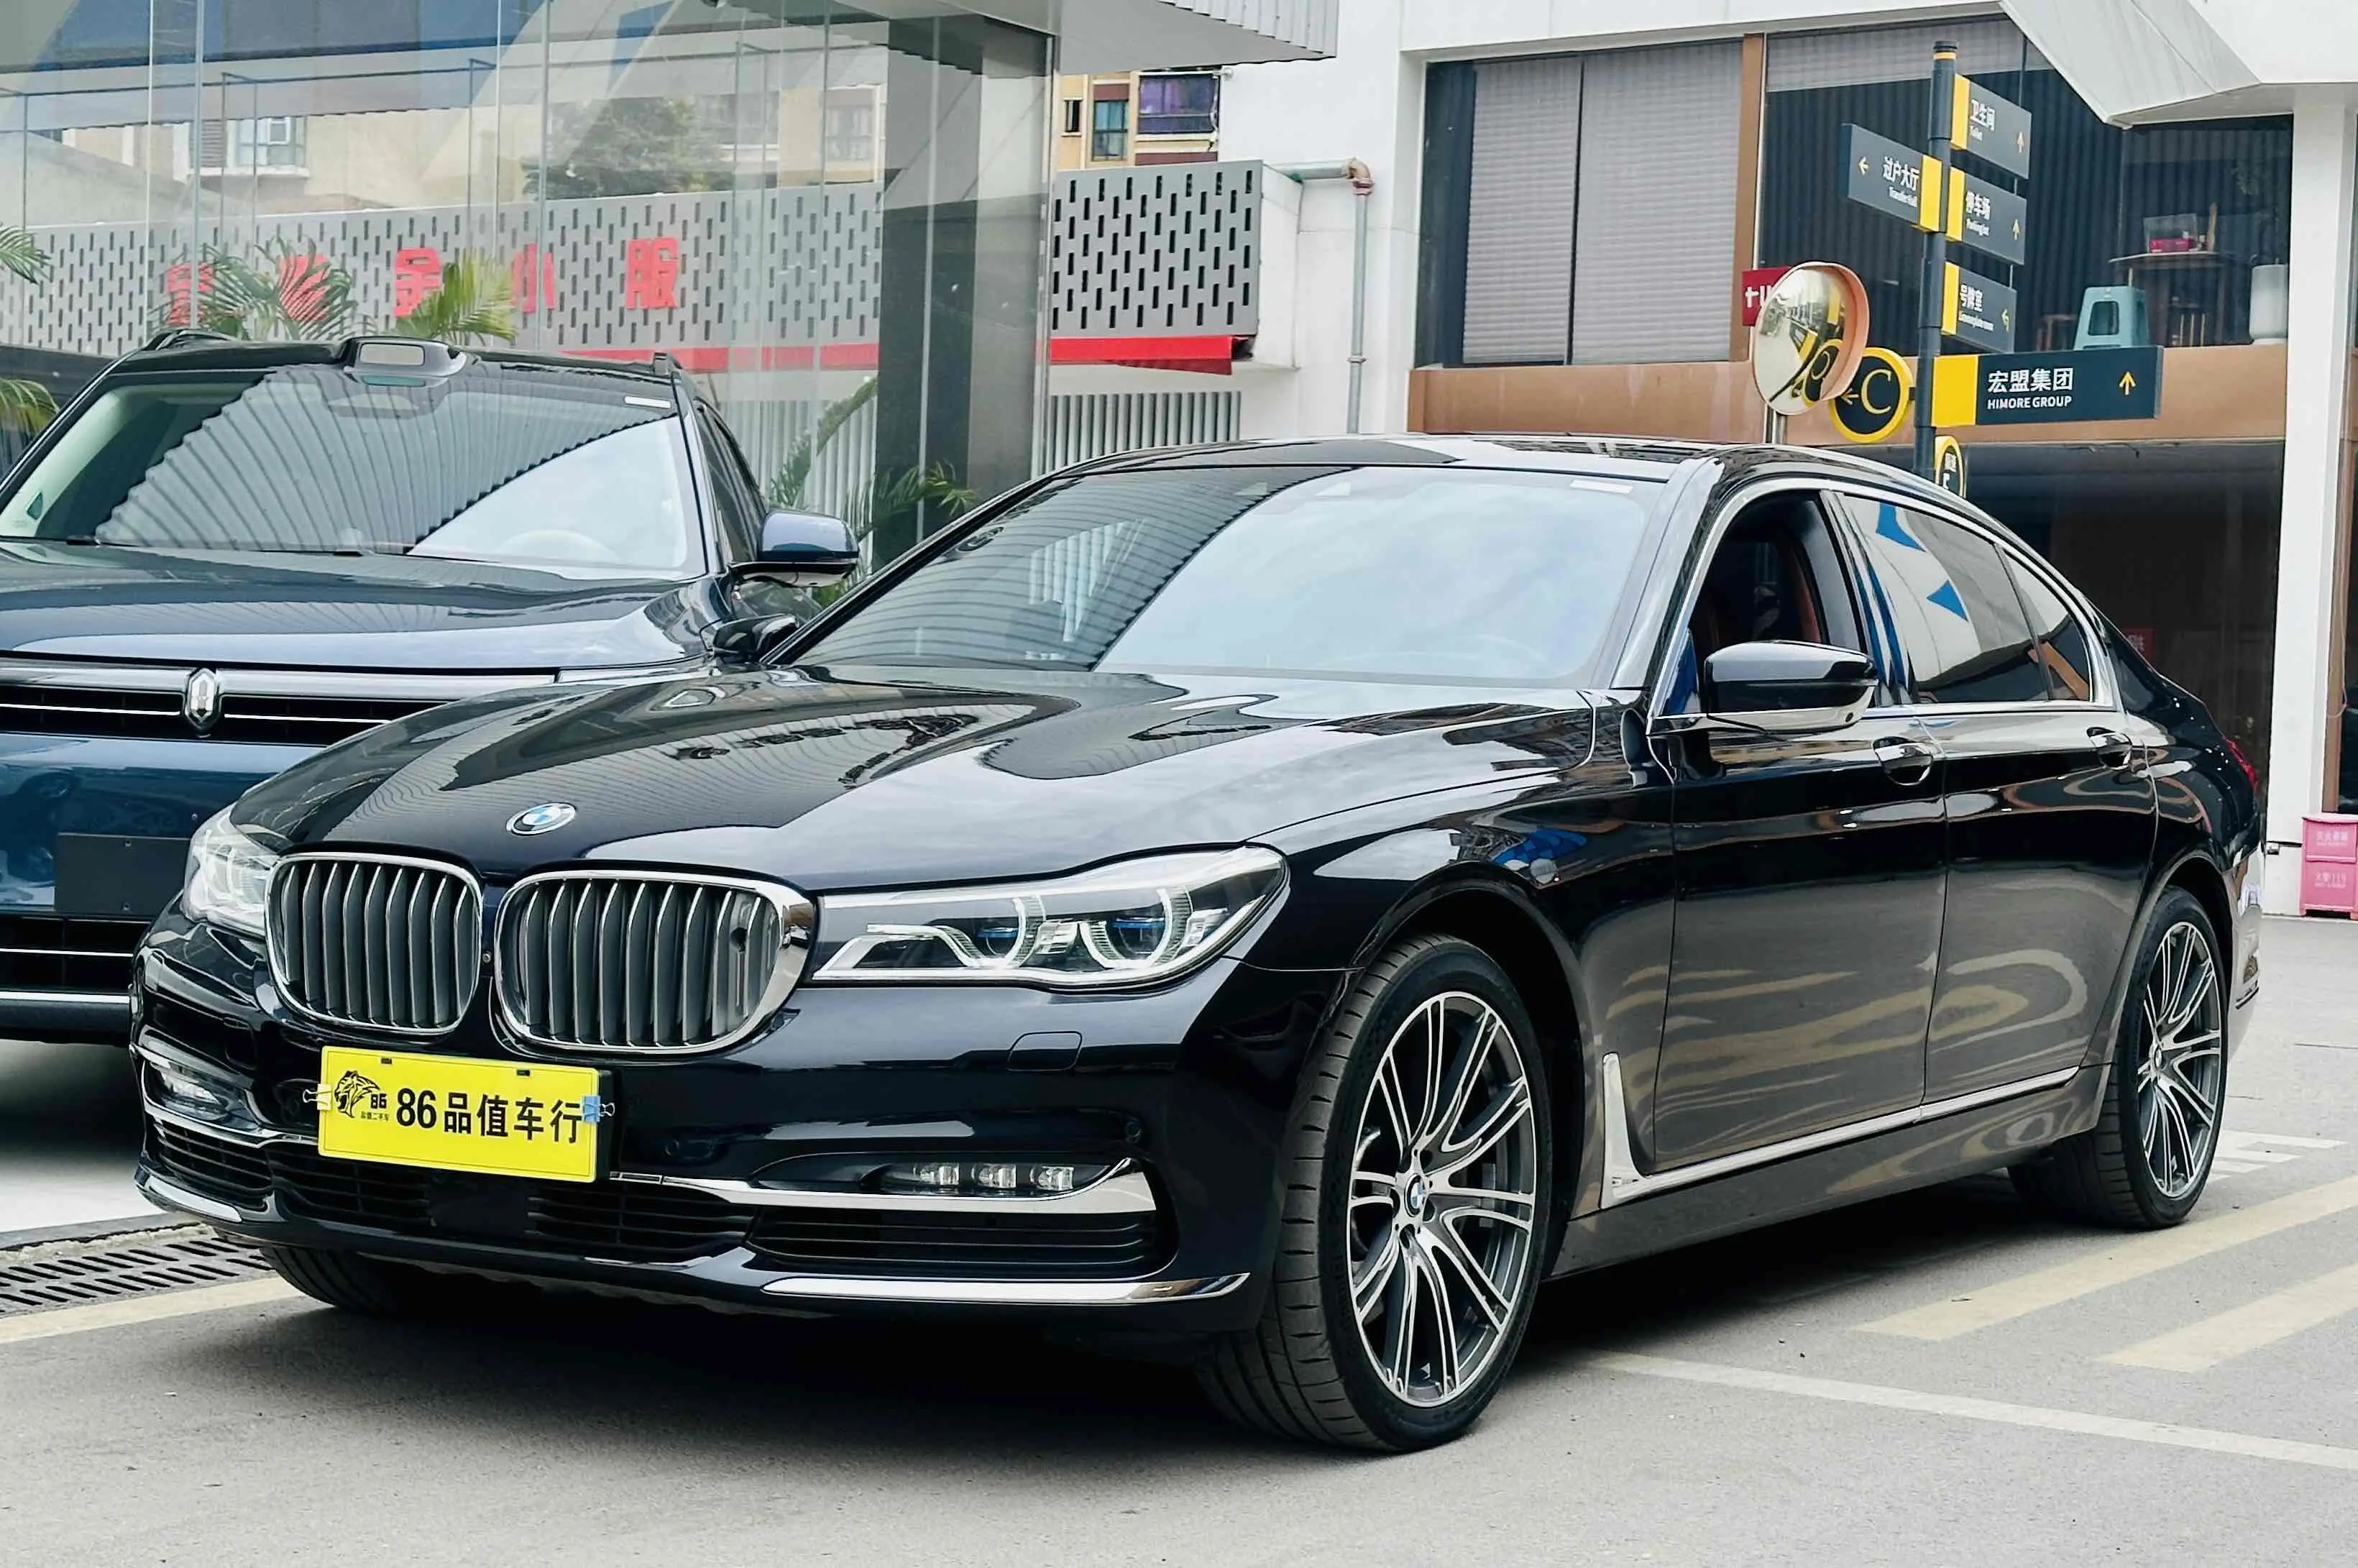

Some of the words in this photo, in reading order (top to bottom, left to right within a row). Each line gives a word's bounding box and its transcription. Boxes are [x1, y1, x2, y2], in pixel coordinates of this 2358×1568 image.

[1883, 156, 1920, 191] 过户大厅
[1861, 369, 1892, 414] C
[1988, 367, 2073, 393] 宏盟集团
[1987, 397, 2031, 409] HIMORE
[2032, 395, 2072, 408] GROUP
[371, 1093, 387, 1109] 86
